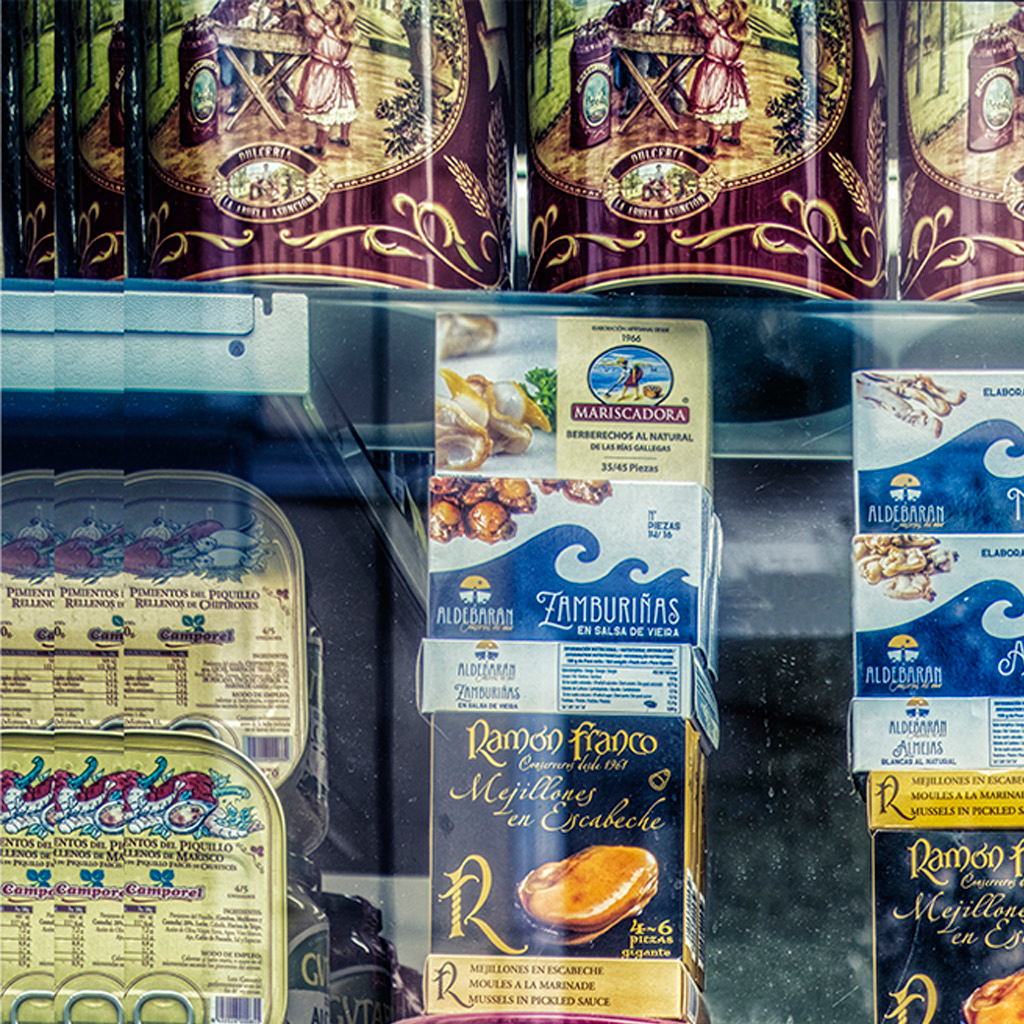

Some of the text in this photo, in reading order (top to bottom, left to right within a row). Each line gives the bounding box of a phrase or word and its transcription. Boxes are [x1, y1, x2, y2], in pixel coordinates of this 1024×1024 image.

[574, 407, 687, 422] MARISCADORA
[567, 430, 694, 442] BERBERECHOS AL NATURAL
[591, 443, 600, 451] DE
[617, 443, 632, 451] RÍAS
[634, 444, 671, 452] GALLEGAS
[601, 462, 659, 473] 35/45 Piezas
[648, 522, 681, 530] PIEZAS
[129, 586, 260, 600] PIMIENTOS DEL PIQUILLO
[134, 598, 259, 612] RELLENOS DE CHIPIRONES
[577, 626, 680, 637] EN SALSA DE VIEIRA
[466, 719, 658, 768] Ramón franco
[450, 772, 597, 816] Mejillones
[506, 798, 666, 832] en Escabeche
[908, 838, 1004, 886] Ramón
[125, 883, 205, 901] Camporel
[950, 930, 979, 946] en
[470, 964, 604, 976] MEJILLONES EN ESCABECHE
[469, 980, 596, 991] MOULES A LA MARINADE
[469, 995, 611, 1007] MUSSELS IN PICKLED SAUCE
